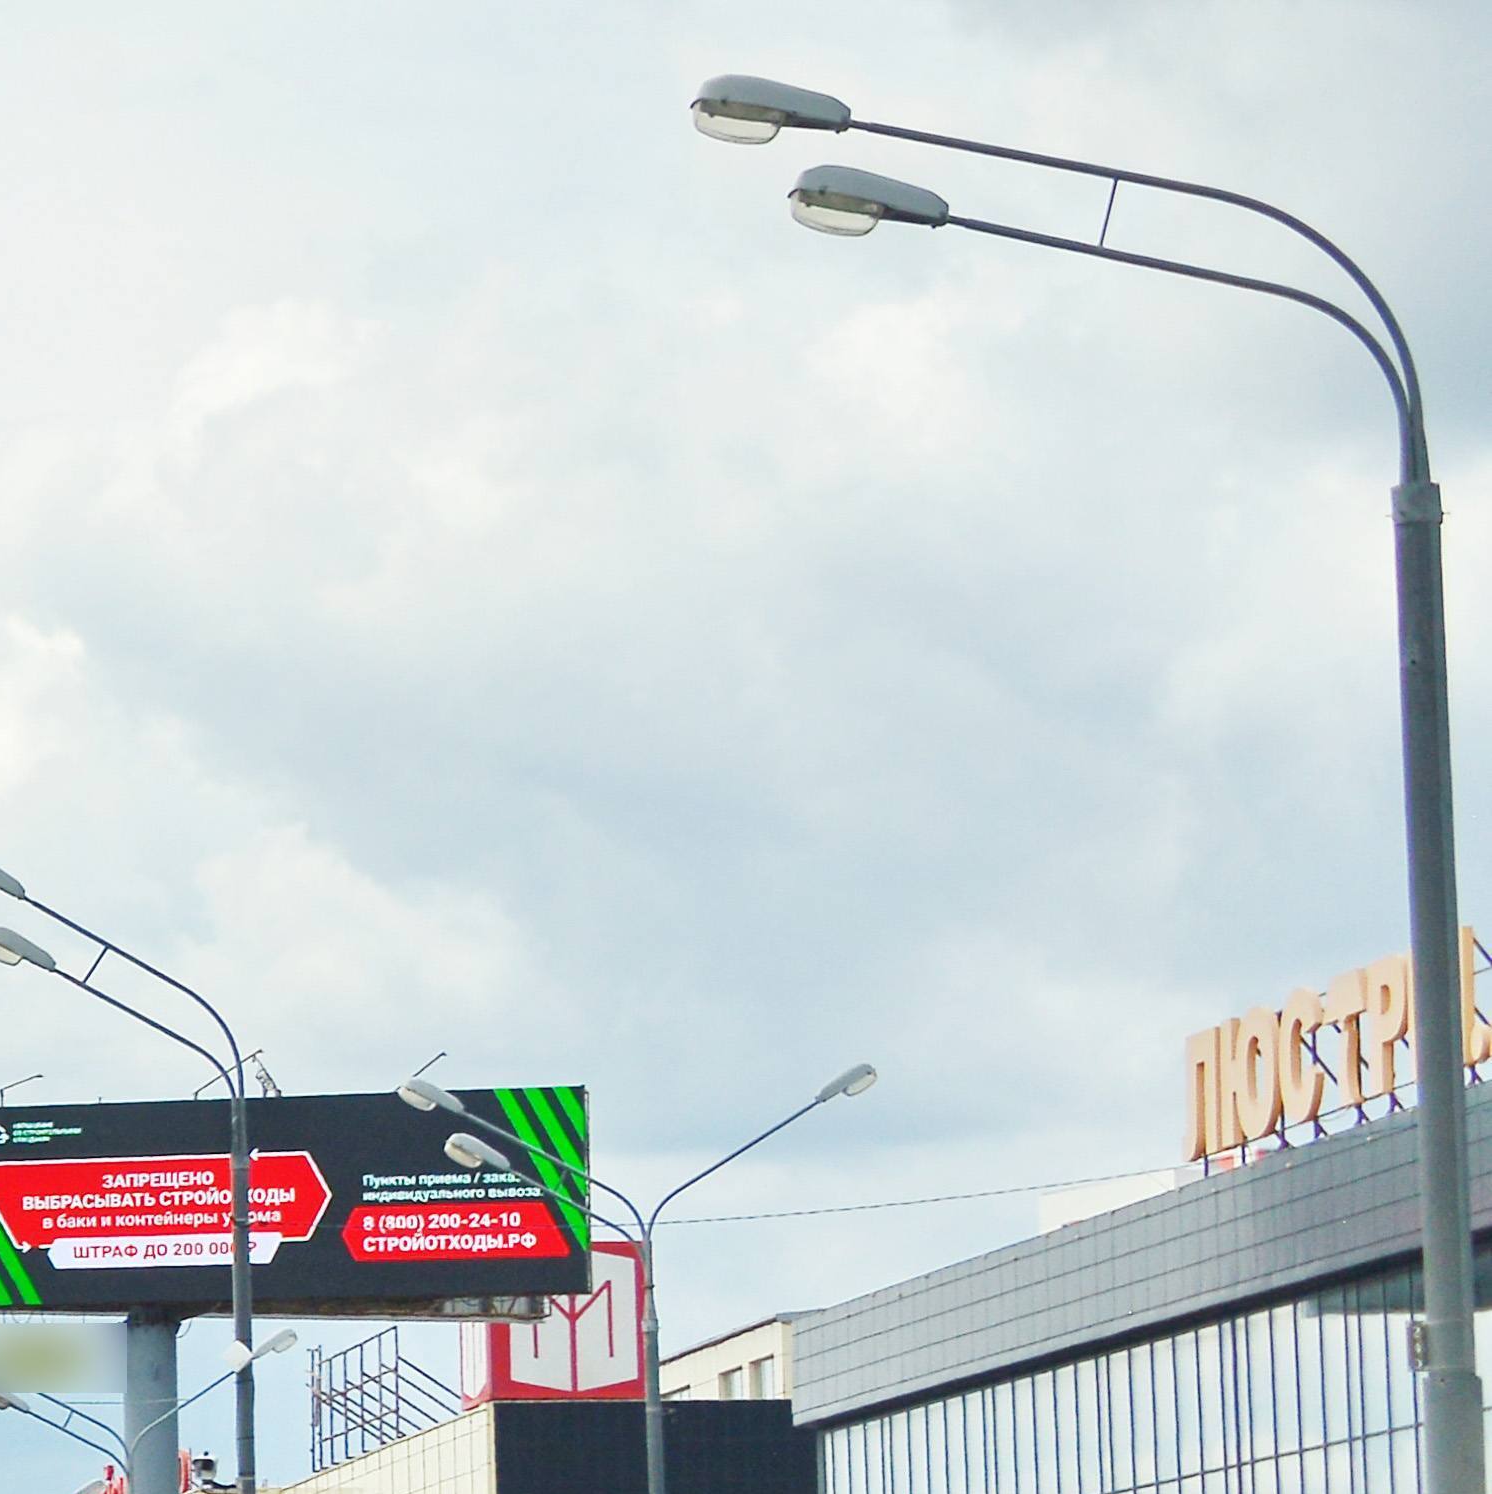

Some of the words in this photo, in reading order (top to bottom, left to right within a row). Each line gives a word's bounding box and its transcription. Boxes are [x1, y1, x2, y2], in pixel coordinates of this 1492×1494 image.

[102, 1171, 214, 1189] ЗАПРЕЩЕНО
[362, 1174, 416, 1190] Пункты
[418, 1174, 471, 1186] приема
[482, 1173, 521, 1184] зака
[22, 1192, 156, 1210] ВЫБРАСЫВАТЬ
[159, 1187, 295, 1206] СТРОЙОХОДЫ
[362, 1188, 485, 1203] индивидуального
[42, 1217, 53, 1229] в
[57, 1214, 97, 1228] баки
[100, 1216, 112, 1227] и
[115, 1211, 218, 1228] контейнеры
[248, 1210, 282, 1223] ома
[363, 1216, 374, 1230] 8
[379, 1215, 425, 1233] (800)
[428, 1212, 521, 1229] 200-24-10
[73, 1245, 138, 1258] ШТРАФ
[143, 1244, 168, 1259] ДО
[173, 1243, 203, 1255] 200
[363, 1232, 537, 1252] СТРОЙОТХОДЫ.РФ
